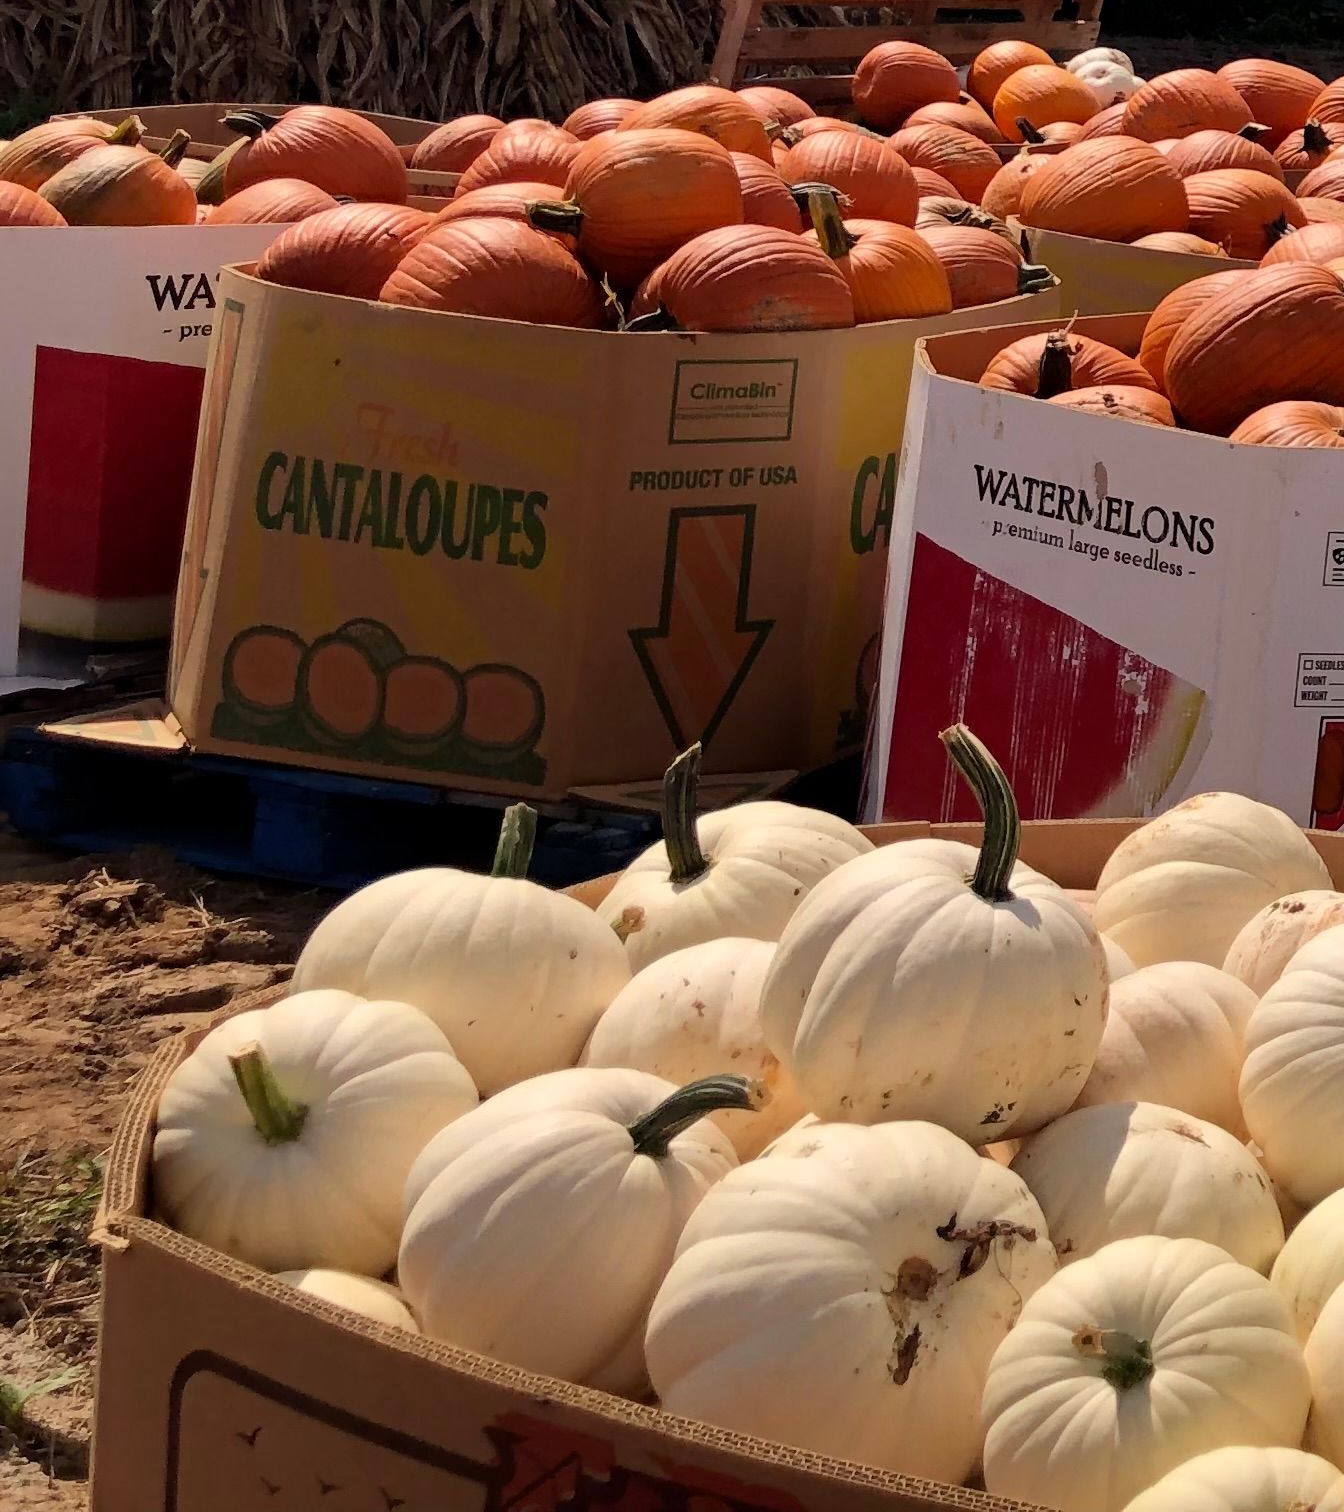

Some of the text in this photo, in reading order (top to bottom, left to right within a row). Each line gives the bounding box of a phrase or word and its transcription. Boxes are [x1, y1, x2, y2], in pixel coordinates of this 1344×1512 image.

[145, 273, 220, 312] WA
[690, 382, 777, 400] ClimaBin
[348, 402, 460, 467] Fresh
[630, 465, 798, 491] PRODUCT OF USA
[256, 451, 548, 570] CANTALOUPES
[974, 464, 1215, 555] WATERMELONS
[1069, 529, 1110, 561] large
[1114, 548, 1183, 577] seedless
[1301, 691, 1328, 701] WEIGHT
[1303, 676, 1327, 686] COUNT
